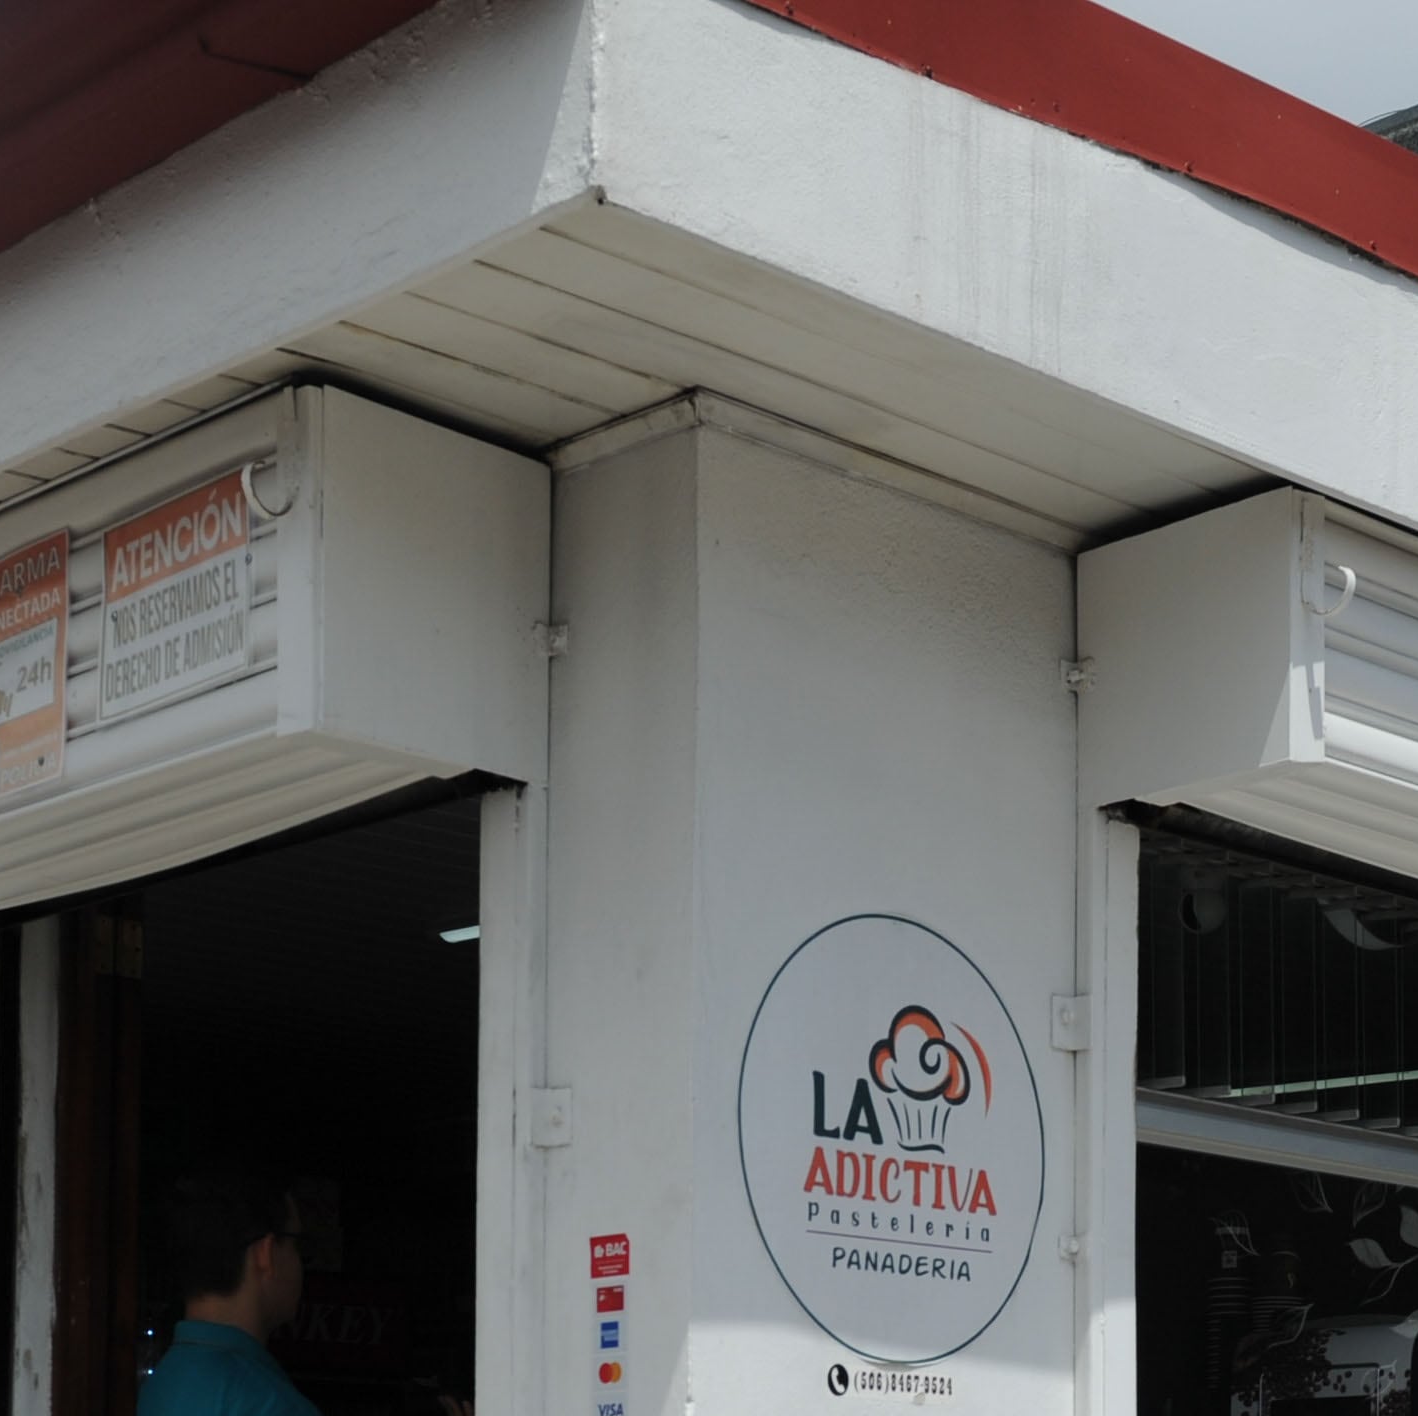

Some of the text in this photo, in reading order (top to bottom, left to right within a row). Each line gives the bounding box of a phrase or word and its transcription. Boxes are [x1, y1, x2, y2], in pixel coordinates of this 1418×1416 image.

[111, 488, 242, 593] ATENCIÓN
[113, 559, 239, 648] NOS RESERVAMOS EL
[16, 655, 53, 693] 24h
[105, 606, 244, 702] DERECHO DE ADMISIÓN
[812, 1070, 883, 1145] LA
[803, 1146, 997, 1216] ADICTIVA
[832, 1247, 971, 1281] PANADERIA
